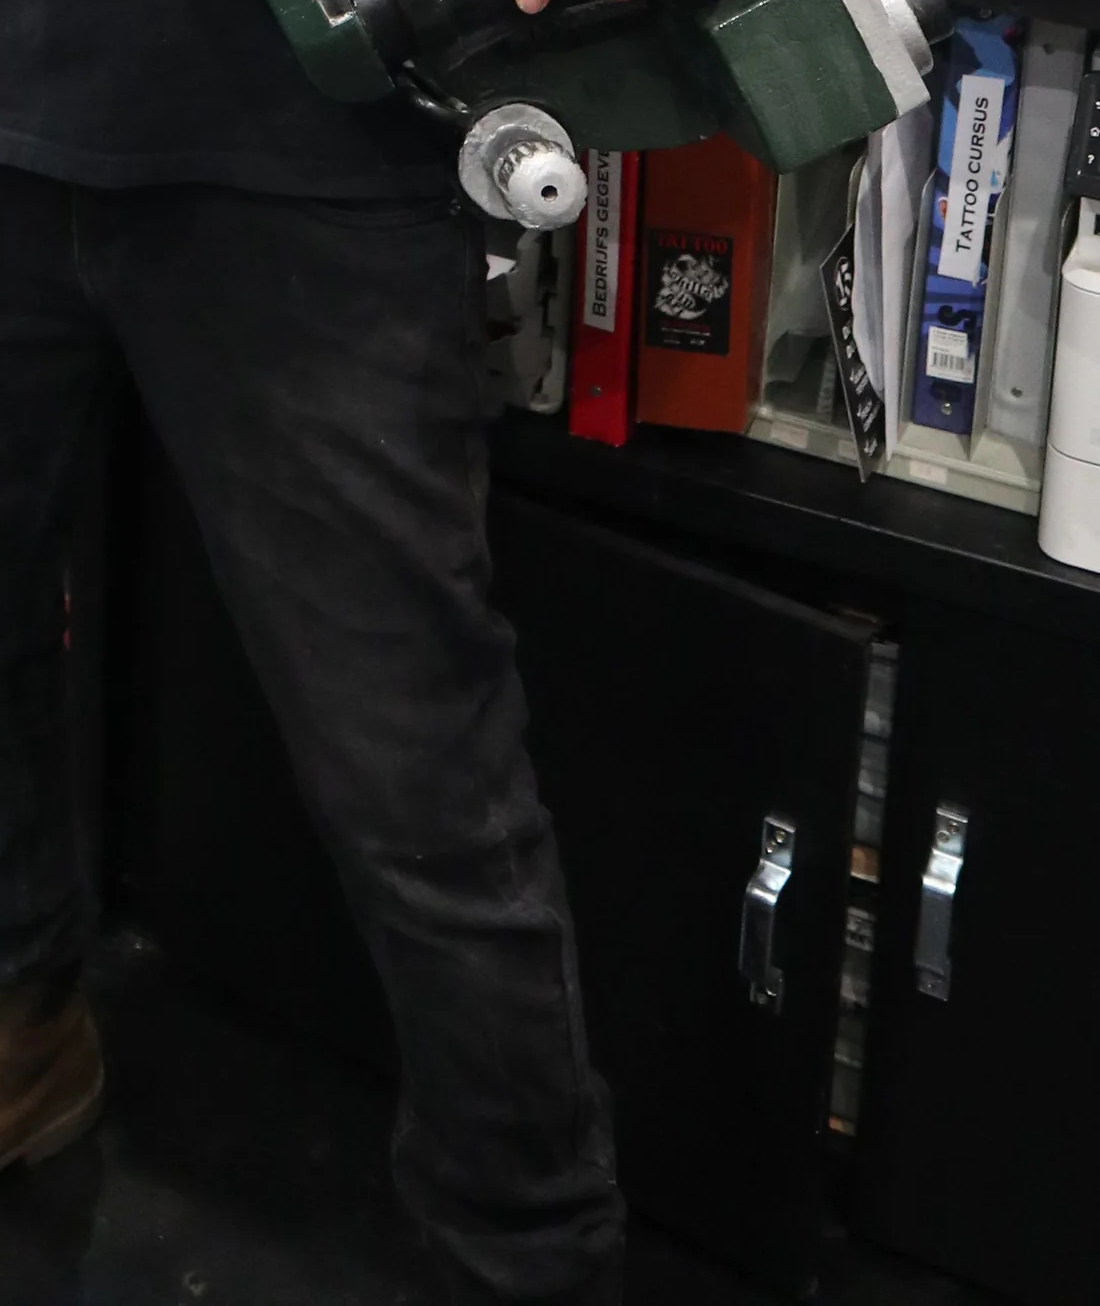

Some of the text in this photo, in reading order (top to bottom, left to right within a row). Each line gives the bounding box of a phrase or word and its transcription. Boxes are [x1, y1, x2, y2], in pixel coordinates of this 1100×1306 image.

[956, 96, 989, 252] TATTOO CURSUS
[592, 227, 609, 318] BEDRIJFS
